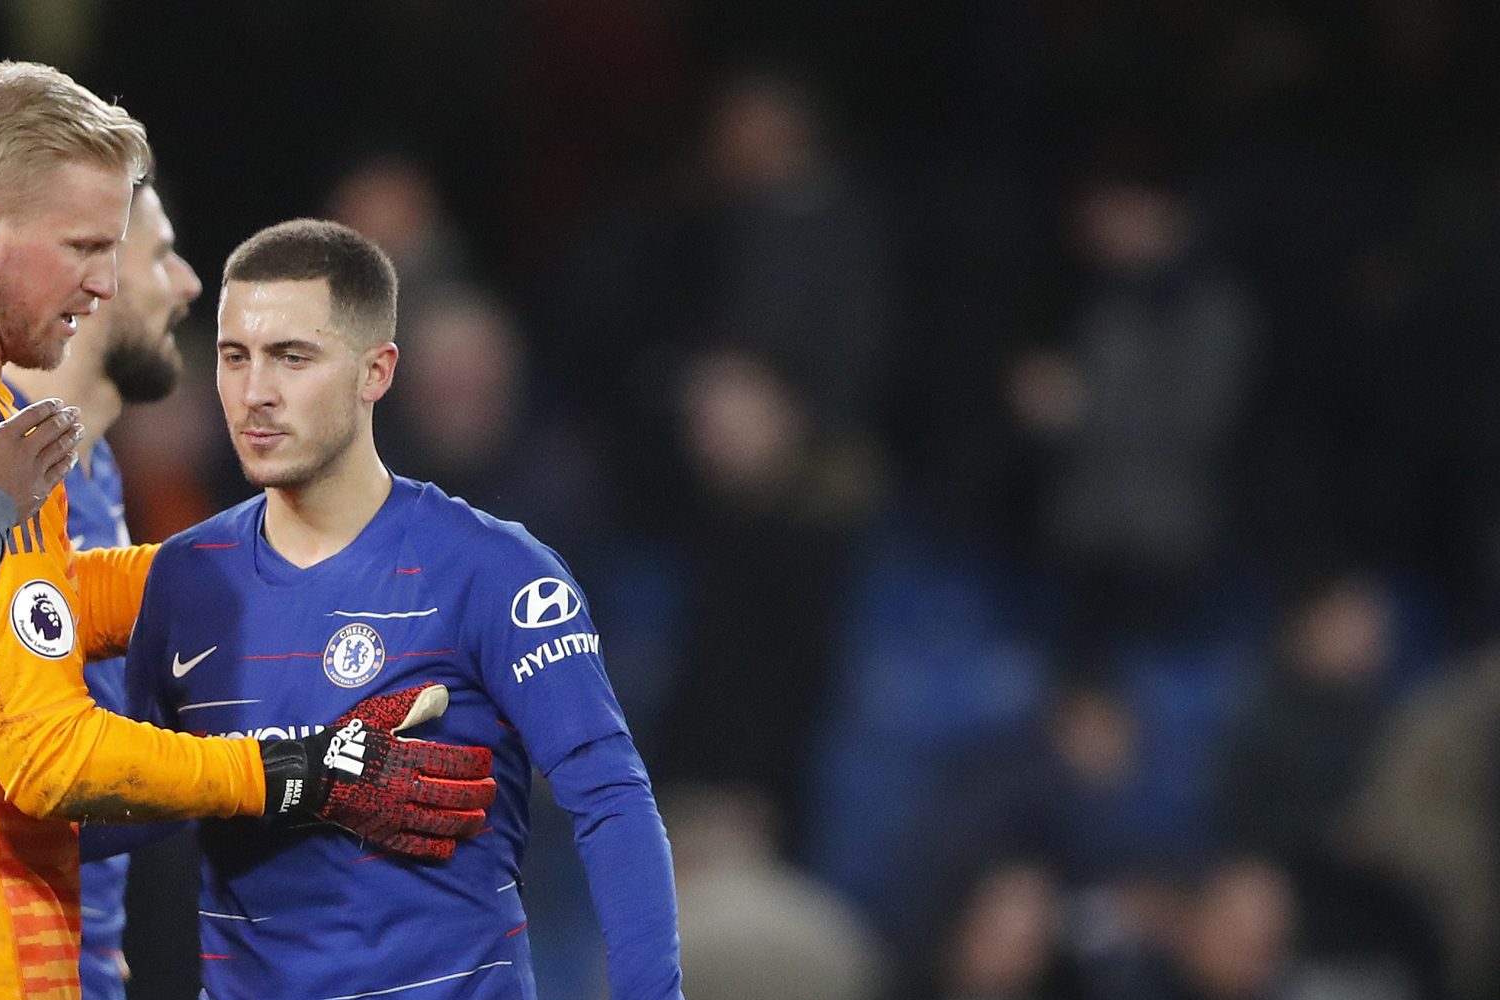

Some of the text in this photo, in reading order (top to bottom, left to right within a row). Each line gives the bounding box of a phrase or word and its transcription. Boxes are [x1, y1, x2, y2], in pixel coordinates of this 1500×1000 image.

[18, 619, 57, 653] Premier League
[339, 626, 377, 643] CHELSEA
[322, 718, 364, 769] adidas
[293, 779, 304, 799] MAX
